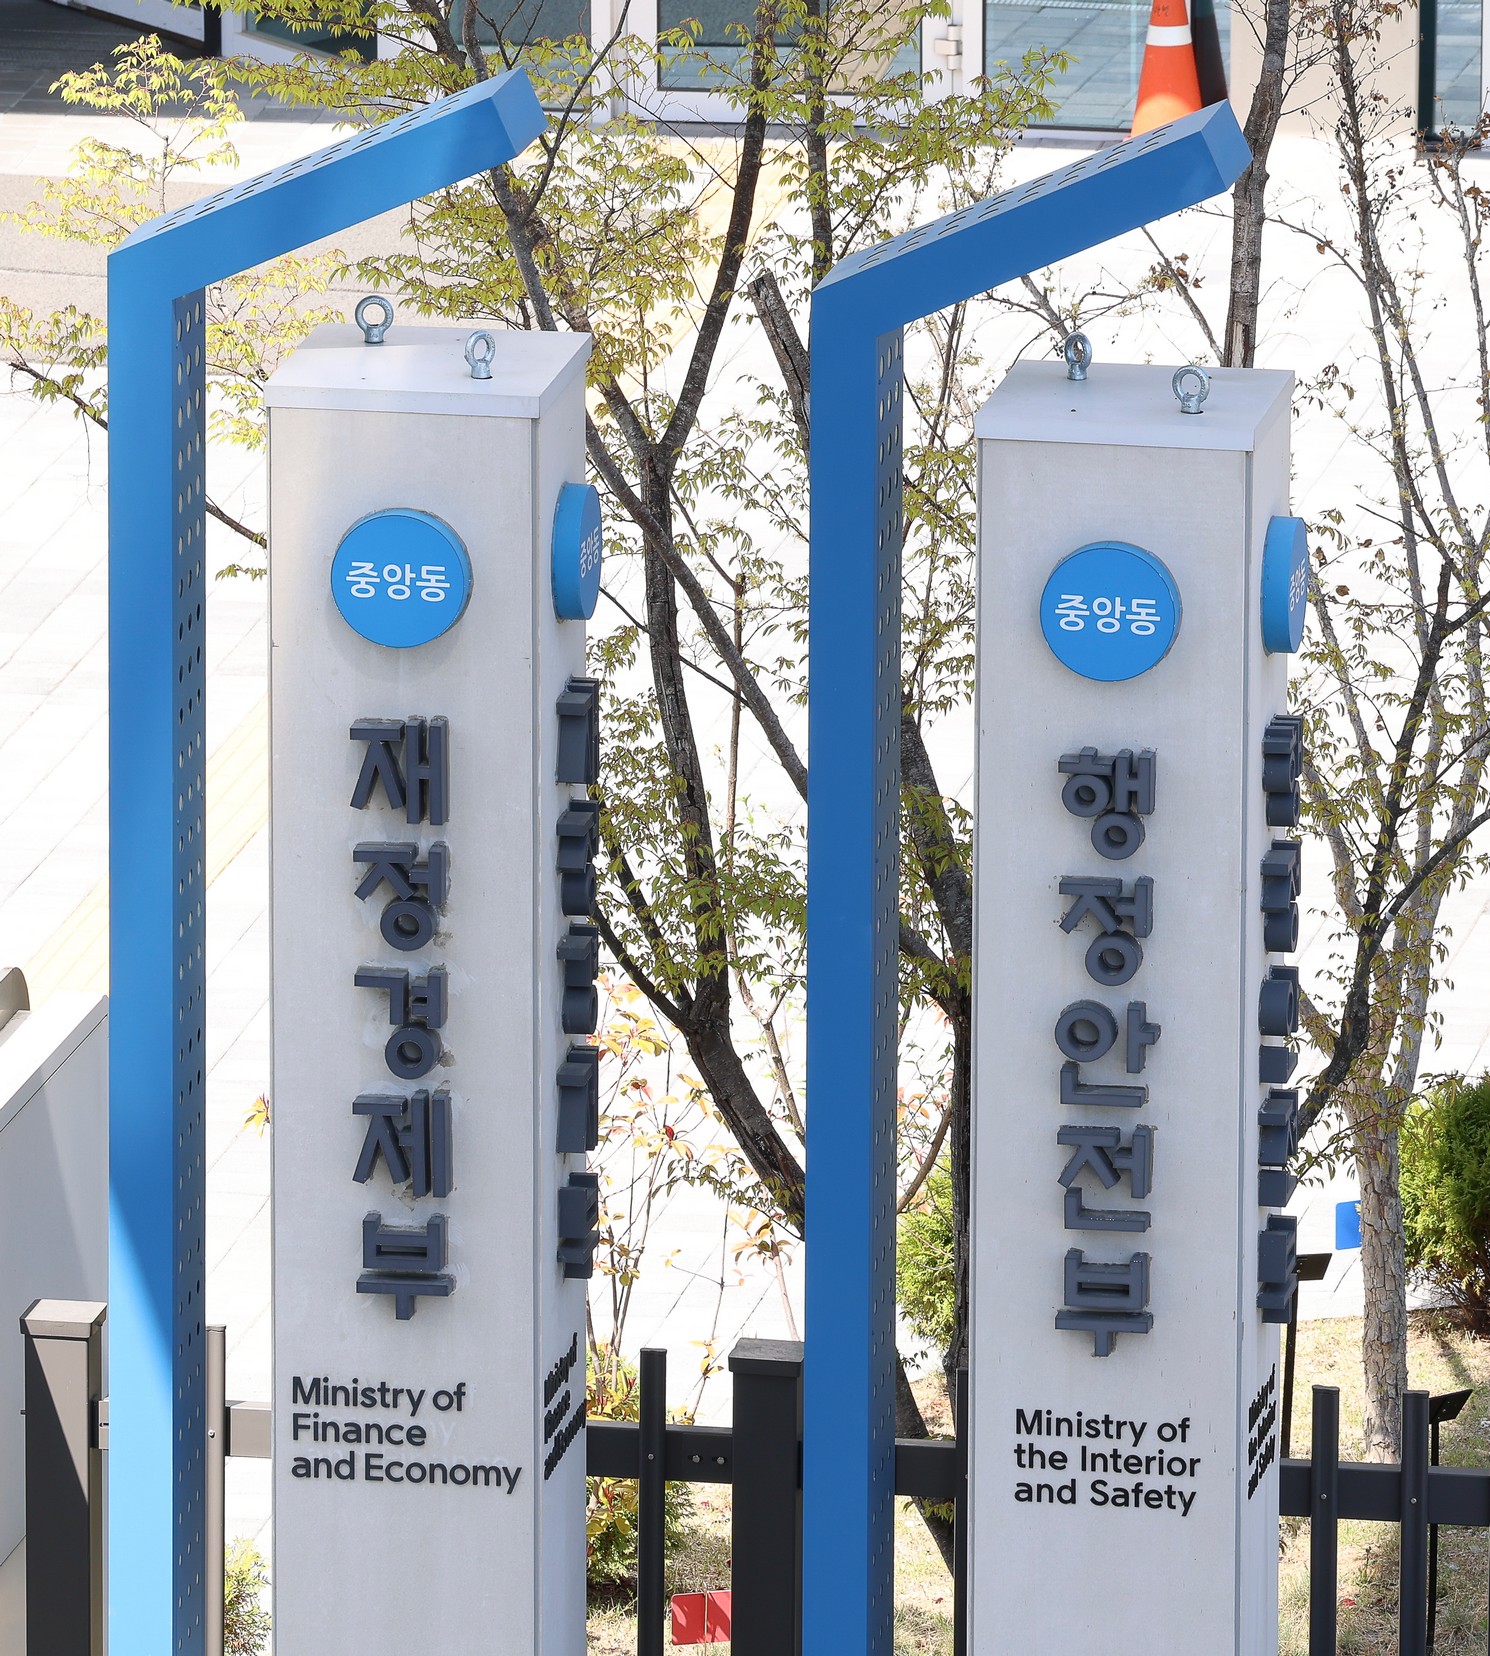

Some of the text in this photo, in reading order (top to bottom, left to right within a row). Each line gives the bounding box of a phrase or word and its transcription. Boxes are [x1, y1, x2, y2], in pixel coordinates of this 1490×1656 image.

[580, 526, 599, 578] 중앙동
[345, 561, 451, 602] 중앙동
[1054, 594, 1161, 636] 중앙동
[350, 718, 452, 1320] 재정경제부
[1055, 747, 1160, 1357] 행정안전부
[292, 1376, 466, 1416] Ministry of
[292, 1412, 427, 1446] Finance
[1015, 1408, 1190, 1447] Ministry of
[291, 1451, 522, 1494] and Economy
[1014, 1443, 1201, 1477] the Interior
[1014, 1478, 1197, 1517] and Safety
